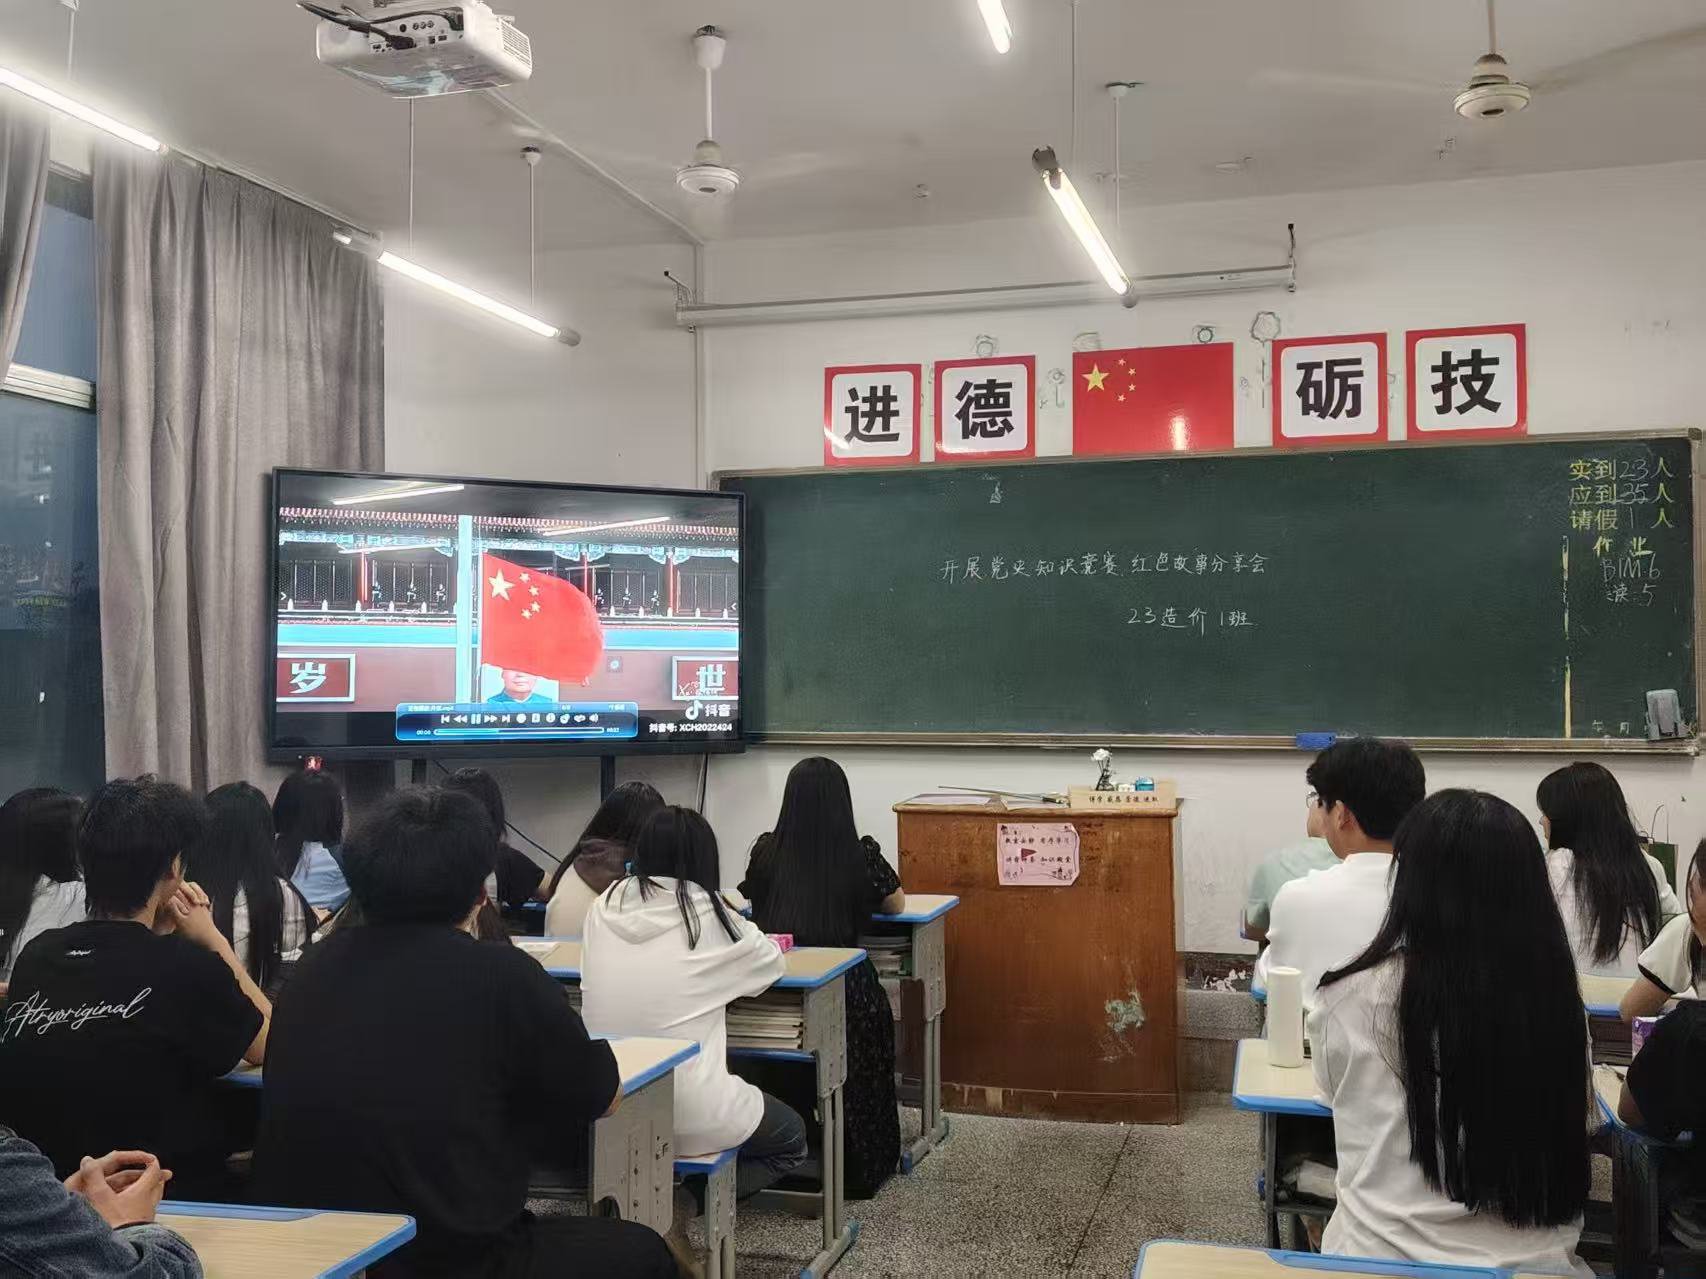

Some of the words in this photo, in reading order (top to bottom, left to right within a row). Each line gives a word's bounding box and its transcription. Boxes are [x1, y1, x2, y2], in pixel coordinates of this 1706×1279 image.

[289, 661, 327, 694] 岁
[696, 663, 727, 692] 世
[705, 703, 731, 717] 抖音
